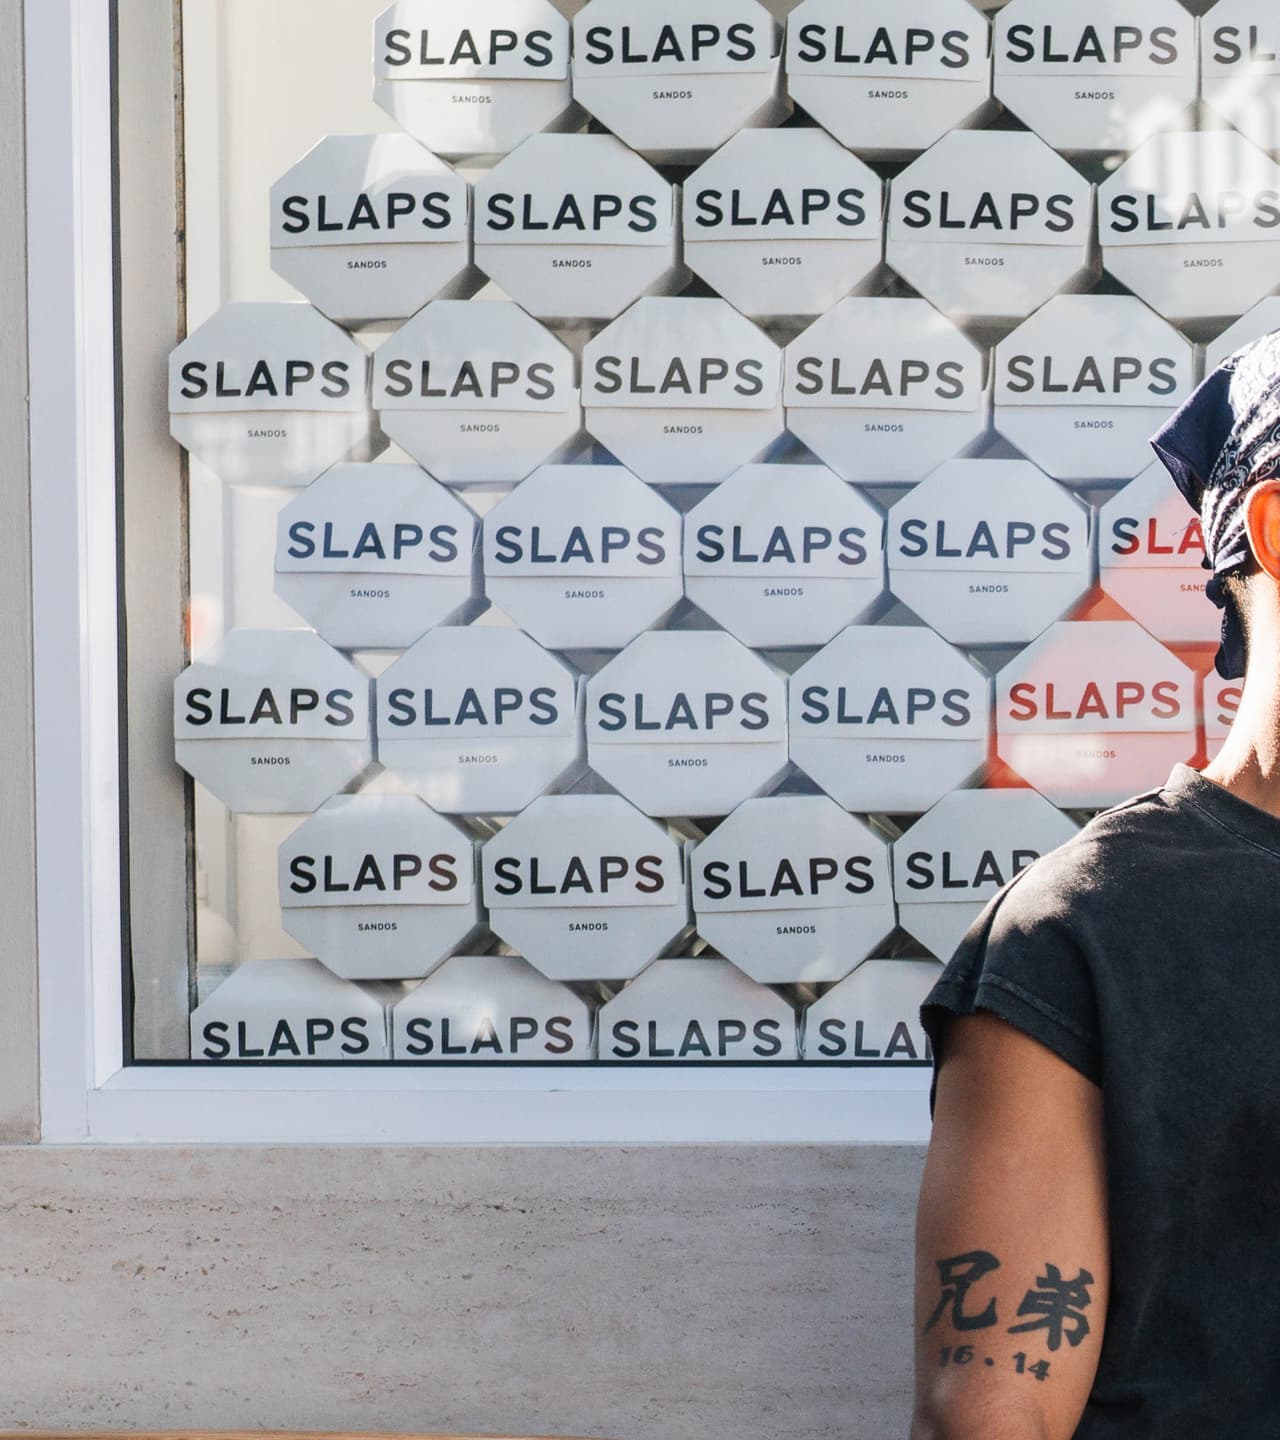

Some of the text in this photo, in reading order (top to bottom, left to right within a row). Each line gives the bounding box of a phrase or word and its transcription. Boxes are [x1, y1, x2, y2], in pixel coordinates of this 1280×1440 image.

[384, 29, 552, 67] SLAPS
[586, 23, 755, 64] SLAPS
[798, 24, 969, 68] SLAPS
[1006, 25, 1177, 64] SLAPS
[452, 96, 491, 104] SANDOS
[653, 91, 692, 99] SANDOS
[868, 91, 908, 99] SANDOS
[1075, 92, 1114, 100] SANDOS
[282, 192, 451, 233] SLAPS
[487, 193, 657, 232] SLAPS
[696, 189, 865, 227] SLAPS
[903, 190, 1073, 232] SLAPS
[348, 261, 387, 269] SANDOS
[553, 260, 591, 268] SANDOS
[762, 257, 802, 265] SANDOS
[965, 257, 1004, 266] SANDOS
[1184, 259, 1223, 267] SANDOS
[181, 360, 349, 398] SLAPS
[385, 360, 555, 400] SLAPS
[594, 356, 763, 396] SLAPS
[796, 357, 964, 399] SLAPS
[1007, 355, 1177, 395] SLAPS
[460, 424, 499, 432] SANDOS
[664, 426, 703, 434] SANDOS
[865, 424, 904, 432] SANDOS
[1074, 421, 1113, 429] SANDOS
[288, 522, 457, 562] SLAPS
[495, 526, 665, 565] SLAPS
[697, 525, 867, 565] SLAPS
[900, 519, 1070, 560] SLAPS
[1111, 517, 1206, 556] SLA
[351, 590, 390, 598] SANDOS
[764, 588, 803, 596] SANDOS
[969, 585, 1008, 593] SANDOS
[1180, 584, 1207, 592] SAND
[186, 688, 354, 726] SLAPS
[388, 687, 558, 726] SLAPS
[599, 693, 769, 731] SLAPS
[802, 686, 970, 726] SLAPS
[1010, 681, 1180, 720] SLAPS
[251, 757, 290, 765] SANDOS
[459, 755, 498, 763] SANDOS
[668, 759, 707, 767] SANDOS
[866, 755, 905, 763] SANDOS
[290, 854, 457, 893] SLAPS
[495, 856, 664, 895] SLAPS
[703, 856, 874, 899] SLAPS
[906, 850, 1041, 890] SLAP
[358, 923, 397, 931] SANDOS
[569, 923, 608, 931] SANDOS
[777, 926, 816, 934] SANDOS
[203, 1017, 370, 1059] SLAPS
[406, 1017, 573, 1055] SLAPS
[612, 1019, 781, 1058] SLAPS
[818, 1018, 932, 1059] SLA
[924, 1250, 1094, 1351] 兄弟
